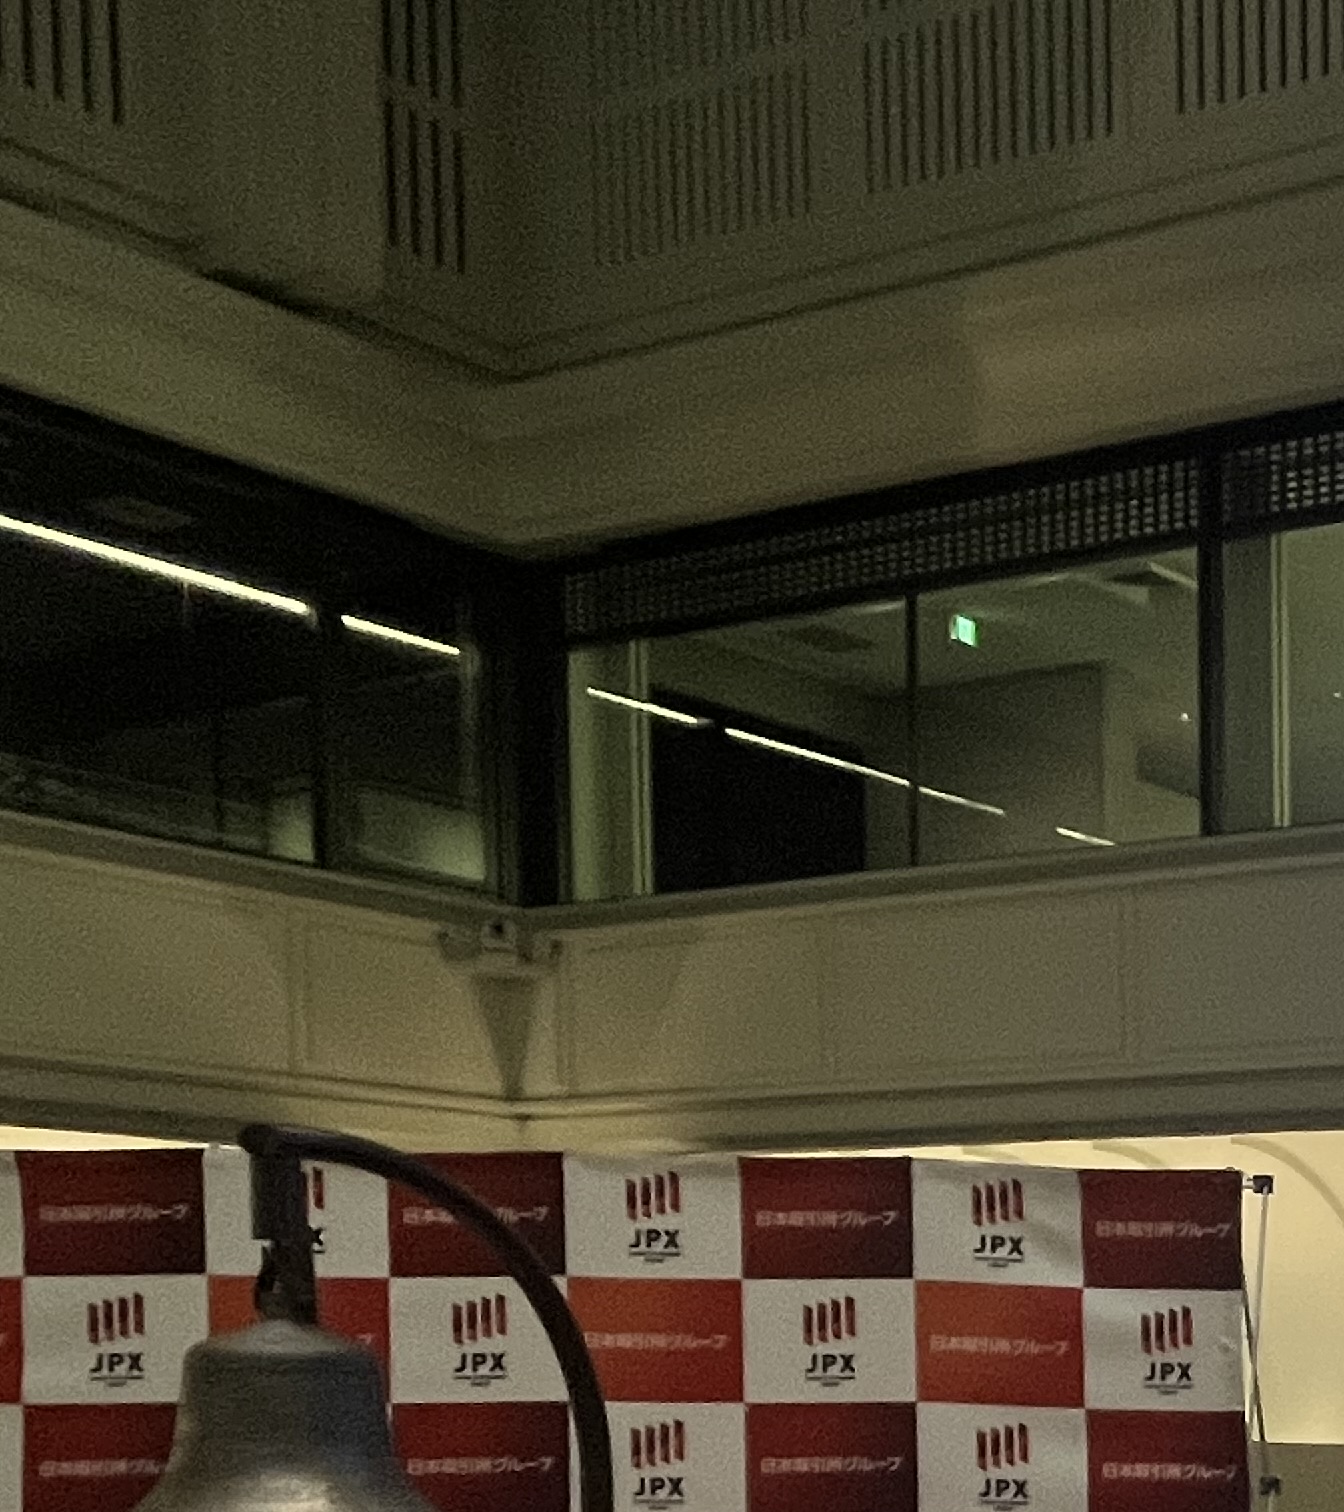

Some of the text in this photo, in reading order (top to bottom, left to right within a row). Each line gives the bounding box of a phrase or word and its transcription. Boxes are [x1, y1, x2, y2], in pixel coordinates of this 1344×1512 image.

[629, 1228, 680, 1250] JPX
[973, 1235, 1023, 1256] JPX
[89, 1352, 143, 1373] JPX
[454, 1352, 505, 1373] JPX
[806, 1353, 855, 1375] JPX
[1145, 1362, 1191, 1382] JPX
[634, 1476, 684, 1498] JPX
[979, 1478, 1028, 1500] JPX
